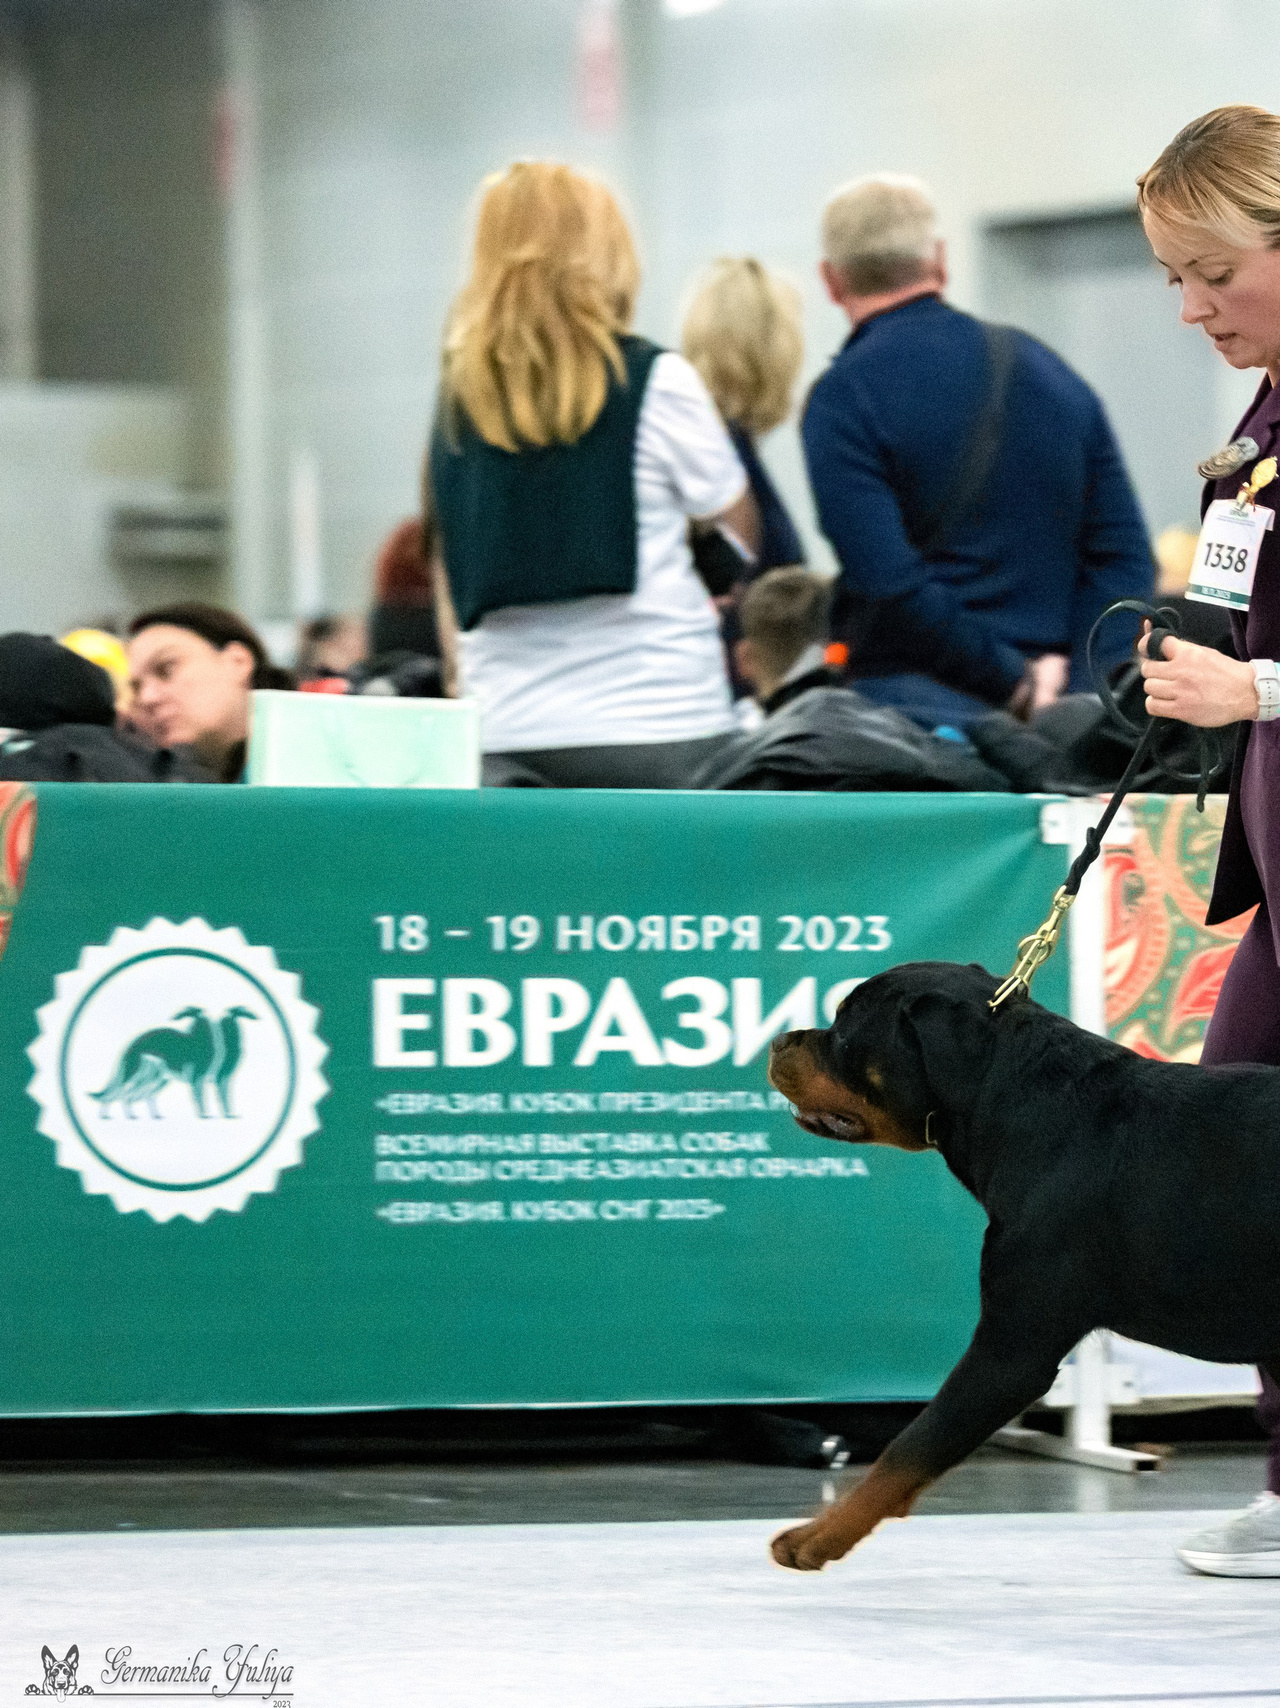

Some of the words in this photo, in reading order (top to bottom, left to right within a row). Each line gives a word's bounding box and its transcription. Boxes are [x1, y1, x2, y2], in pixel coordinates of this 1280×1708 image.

[1204, 542, 1248, 573] 1338
[373, 915, 429, 952] 18
[486, 915, 541, 952] 19
[555, 914, 762, 952] НОЯБРЯ
[776, 914, 892, 952] 2023
[371, 976, 870, 1068] ЕВРАЗИ
[508, 1092, 595, 1114] КУБОК
[599, 1091, 767, 1115] ПРЕЗИДЕНТА
[374, 1134, 535, 1156] ВСЕМИРНАЯ
[539, 1132, 678, 1154] ВЫСТАВКА
[680, 1132, 772, 1152] СОБАК
[374, 1160, 492, 1183] ПОРОДЫ
[749, 1157, 870, 1178] ОВЧАРКА
[510, 1200, 595, 1222] КУБОК
